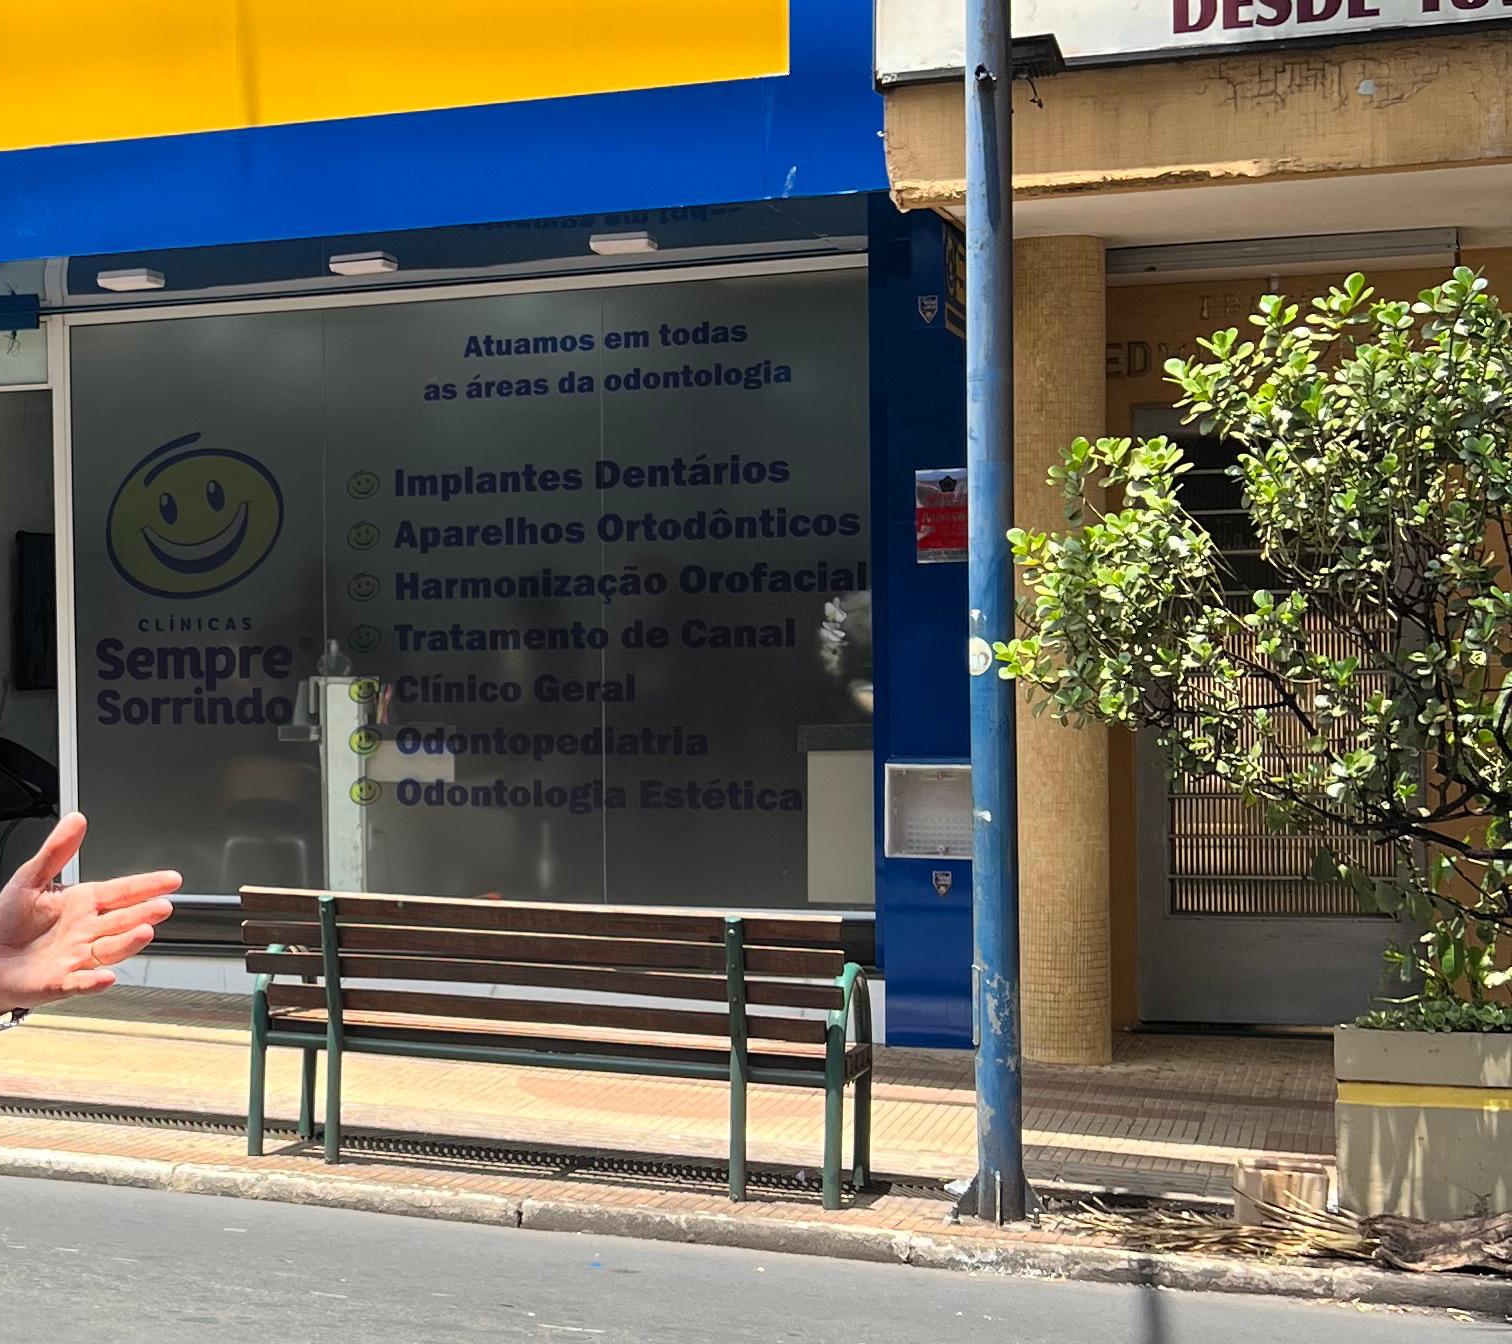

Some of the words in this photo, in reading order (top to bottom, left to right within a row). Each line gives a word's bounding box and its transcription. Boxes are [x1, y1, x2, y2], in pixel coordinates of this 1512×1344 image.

[463, 332, 595, 358] Atuamos
[604, 328, 650, 350] em
[659, 321, 748, 347] todas
[423, 381, 458, 401] as
[465, 375, 550, 399] áreas
[558, 371, 594, 394] da
[604, 360, 792, 392] odontologia
[395, 464, 584, 502] Implantes
[595, 455, 790, 490] Dentários
[394, 517, 586, 554] Aparelhos
[597, 508, 861, 544] Ortodônticos
[394, 565, 668, 605] Harmonização
[678, 561, 868, 594] Orofacial
[138, 614, 253, 633] CLÍNICAS
[394, 621, 609, 652] Tratamento
[620, 620, 670, 650] de
[680, 618, 796, 649] Canal
[96, 637, 293, 692] Sempre
[96, 687, 294, 726] Sorrindo
[395, 672, 522, 704] Clínico
[533, 673, 636, 704] Geral
[396, 725, 709, 760] Odontopediatria
[396, 777, 626, 815] Odontologia
[639, 777, 803, 812] Estética
